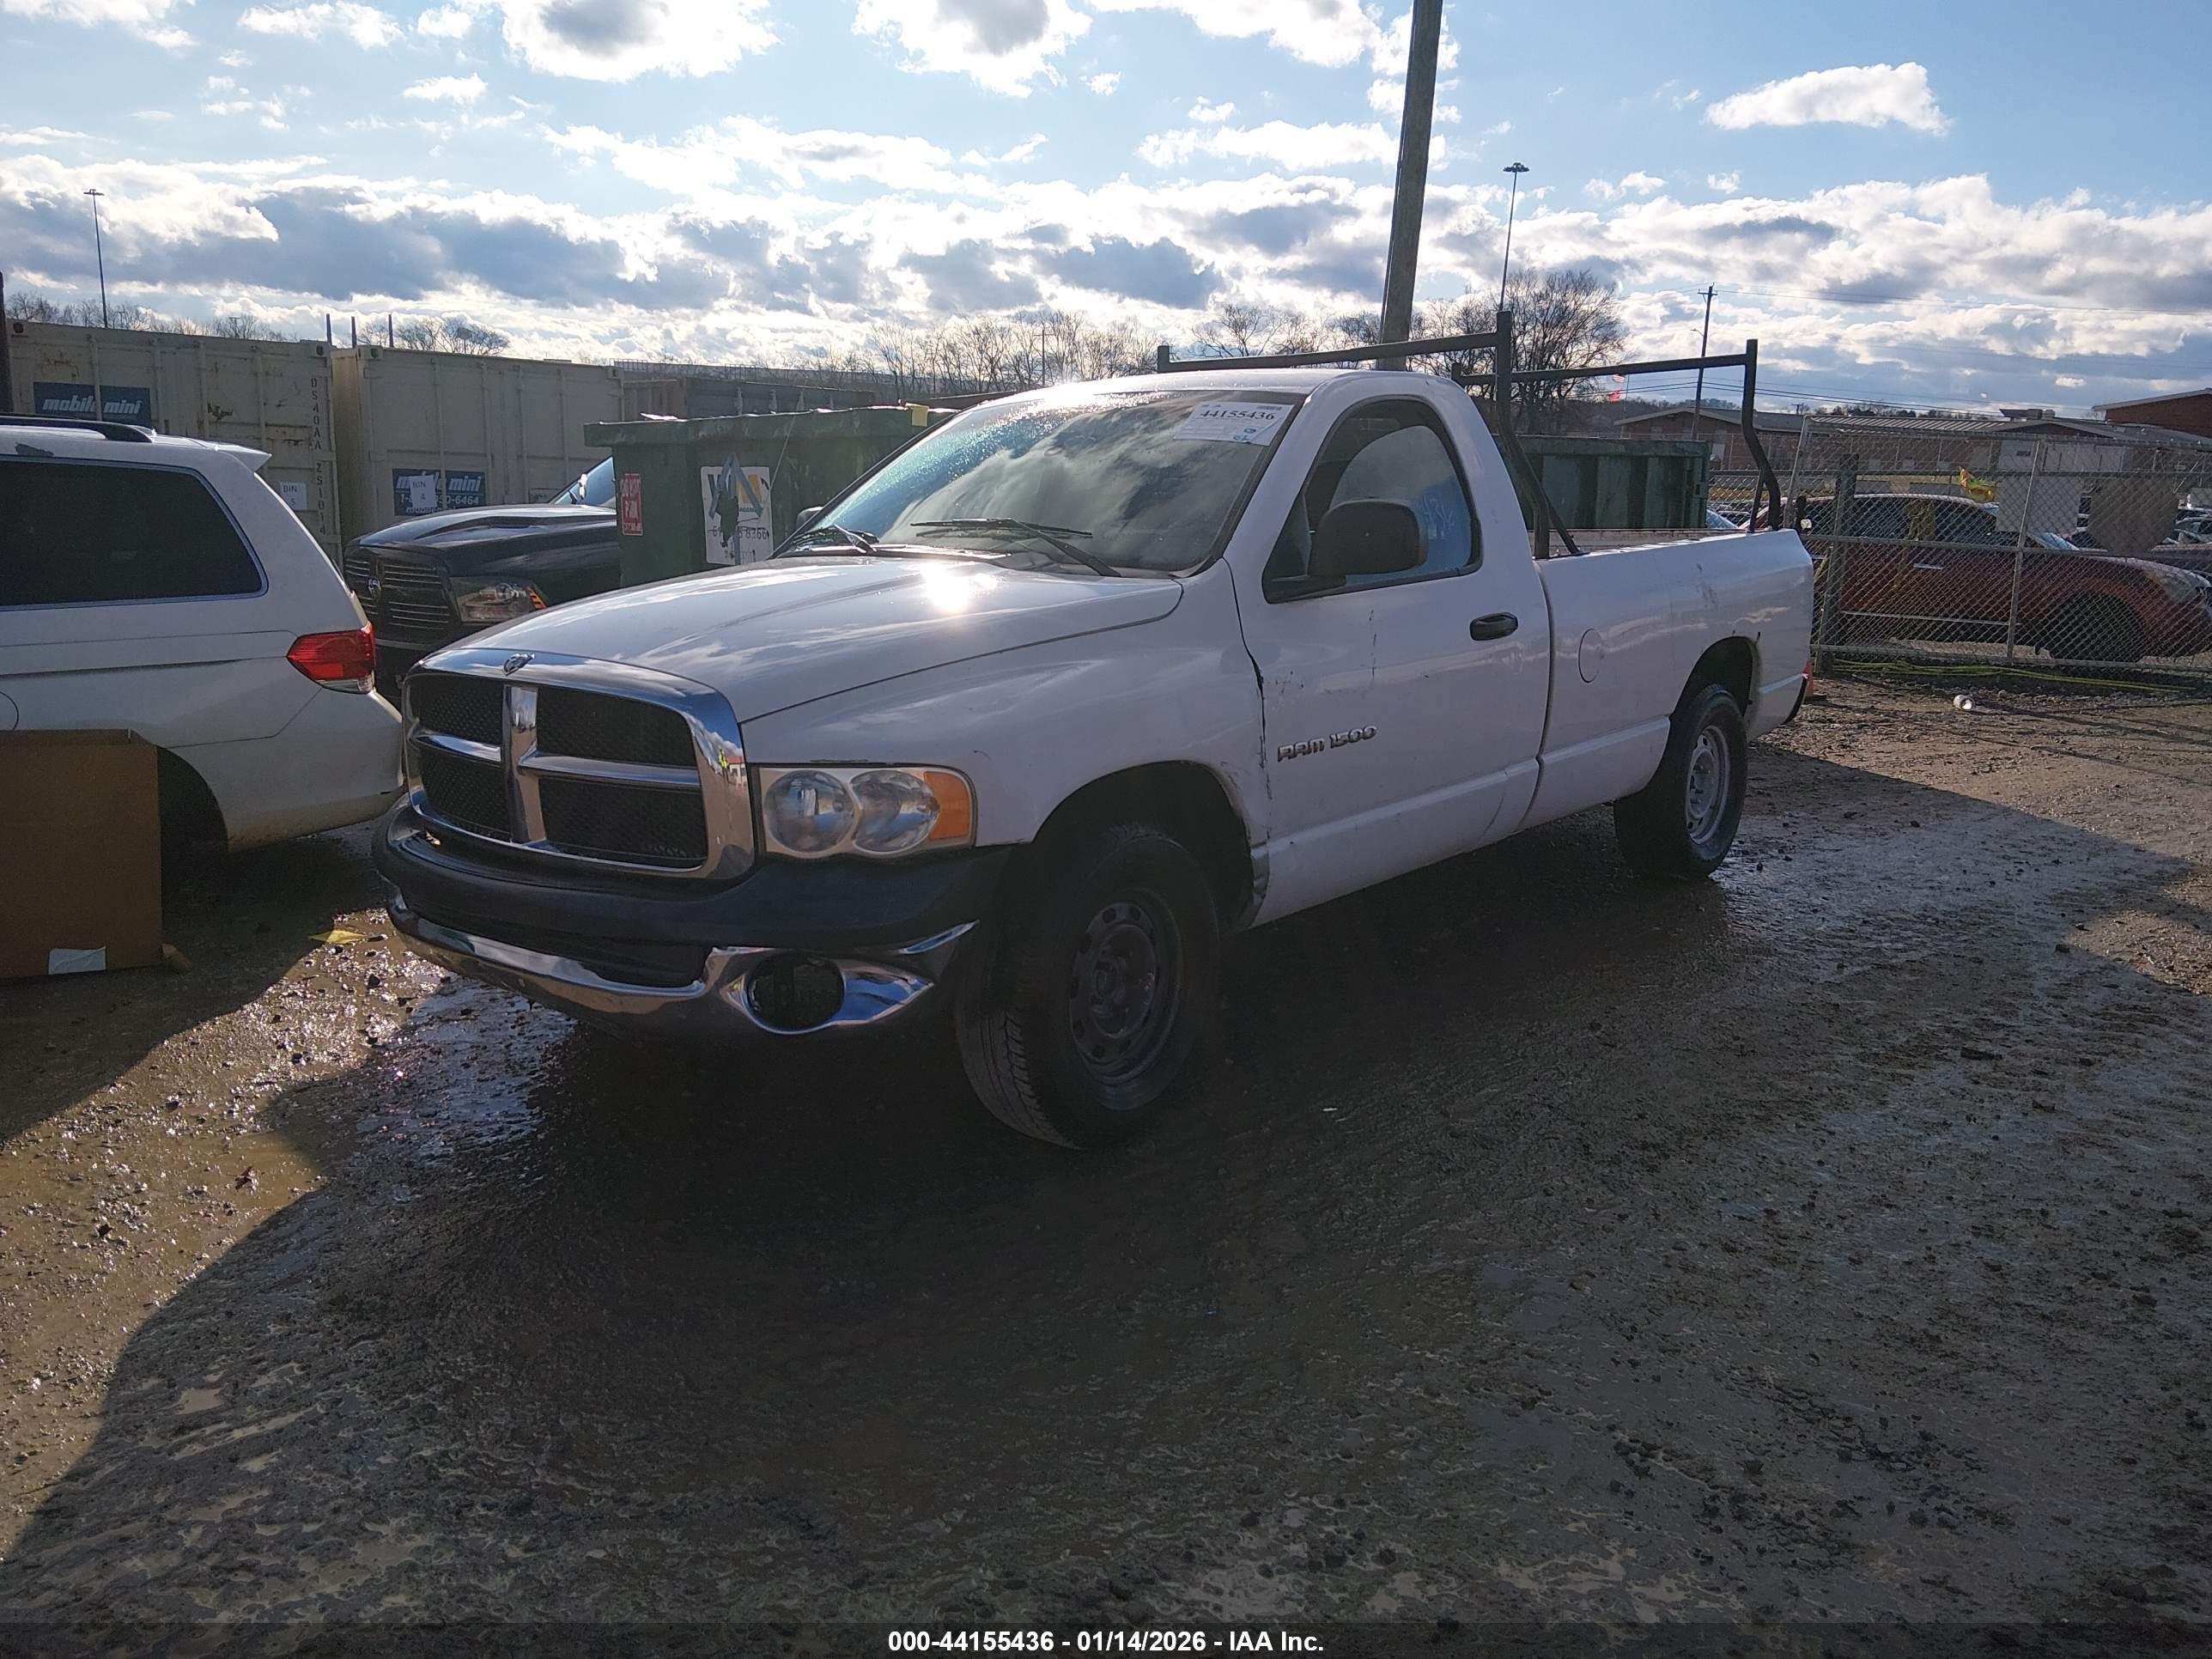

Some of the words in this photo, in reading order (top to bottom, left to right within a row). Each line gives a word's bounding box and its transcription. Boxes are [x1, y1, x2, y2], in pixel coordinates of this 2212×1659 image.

[103, 399, 143, 414] mini
[1200, 410, 1275, 421] 44155436
[283, 484, 298, 493] BIN
[448, 475, 482, 491] mini
[1329, 725, 1377, 749] 1500
